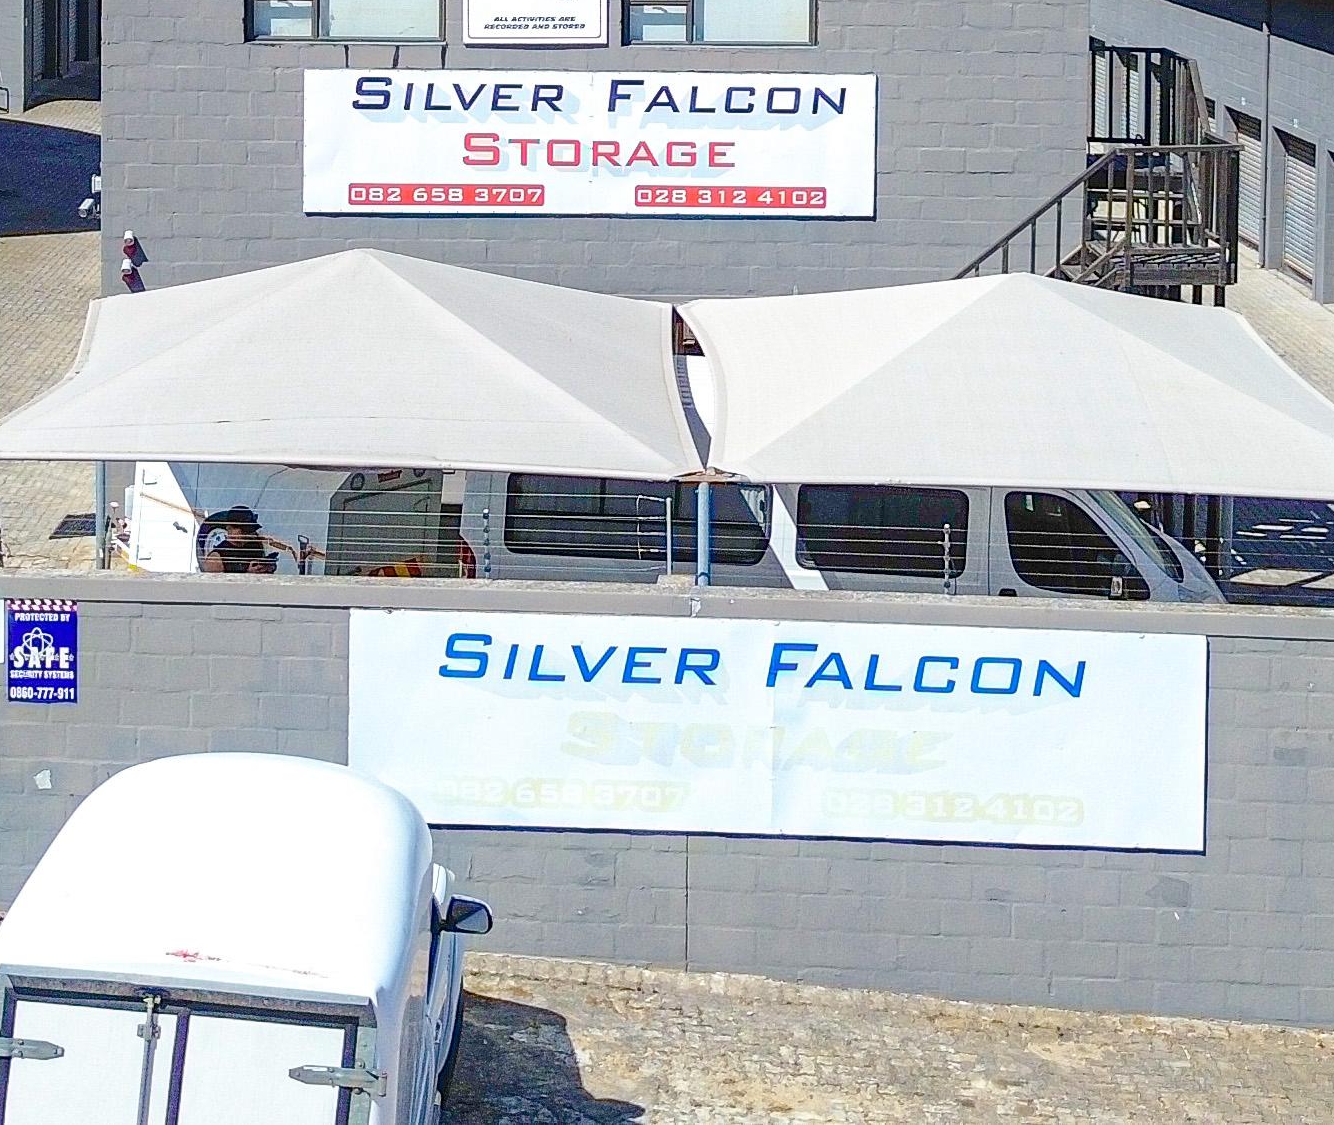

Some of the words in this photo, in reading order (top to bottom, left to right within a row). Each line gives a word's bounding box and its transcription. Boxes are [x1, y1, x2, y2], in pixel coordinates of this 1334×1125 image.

[352, 76, 564, 112] SILVER
[608, 79, 847, 114] FALCON
[462, 132, 736, 167] STORAGE
[350, 187, 402, 202] 082
[413, 187, 464, 203] 658
[474, 187, 543, 203] 3707
[637, 189, 687, 204] 028
[697, 189, 747, 204] 312
[757, 190, 824, 205] 4102
[14, 612, 59, 622] PROTECTED
[60, 614, 71, 622] BY
[13, 647, 70, 669] SAFE
[438, 633, 721, 686] SILVER
[765, 642, 1086, 698] FALCON
[9, 670, 42, 679] SECURITY
[43, 671, 75, 680] SYSTEMS
[9, 686, 75, 700] 0860-777-911
